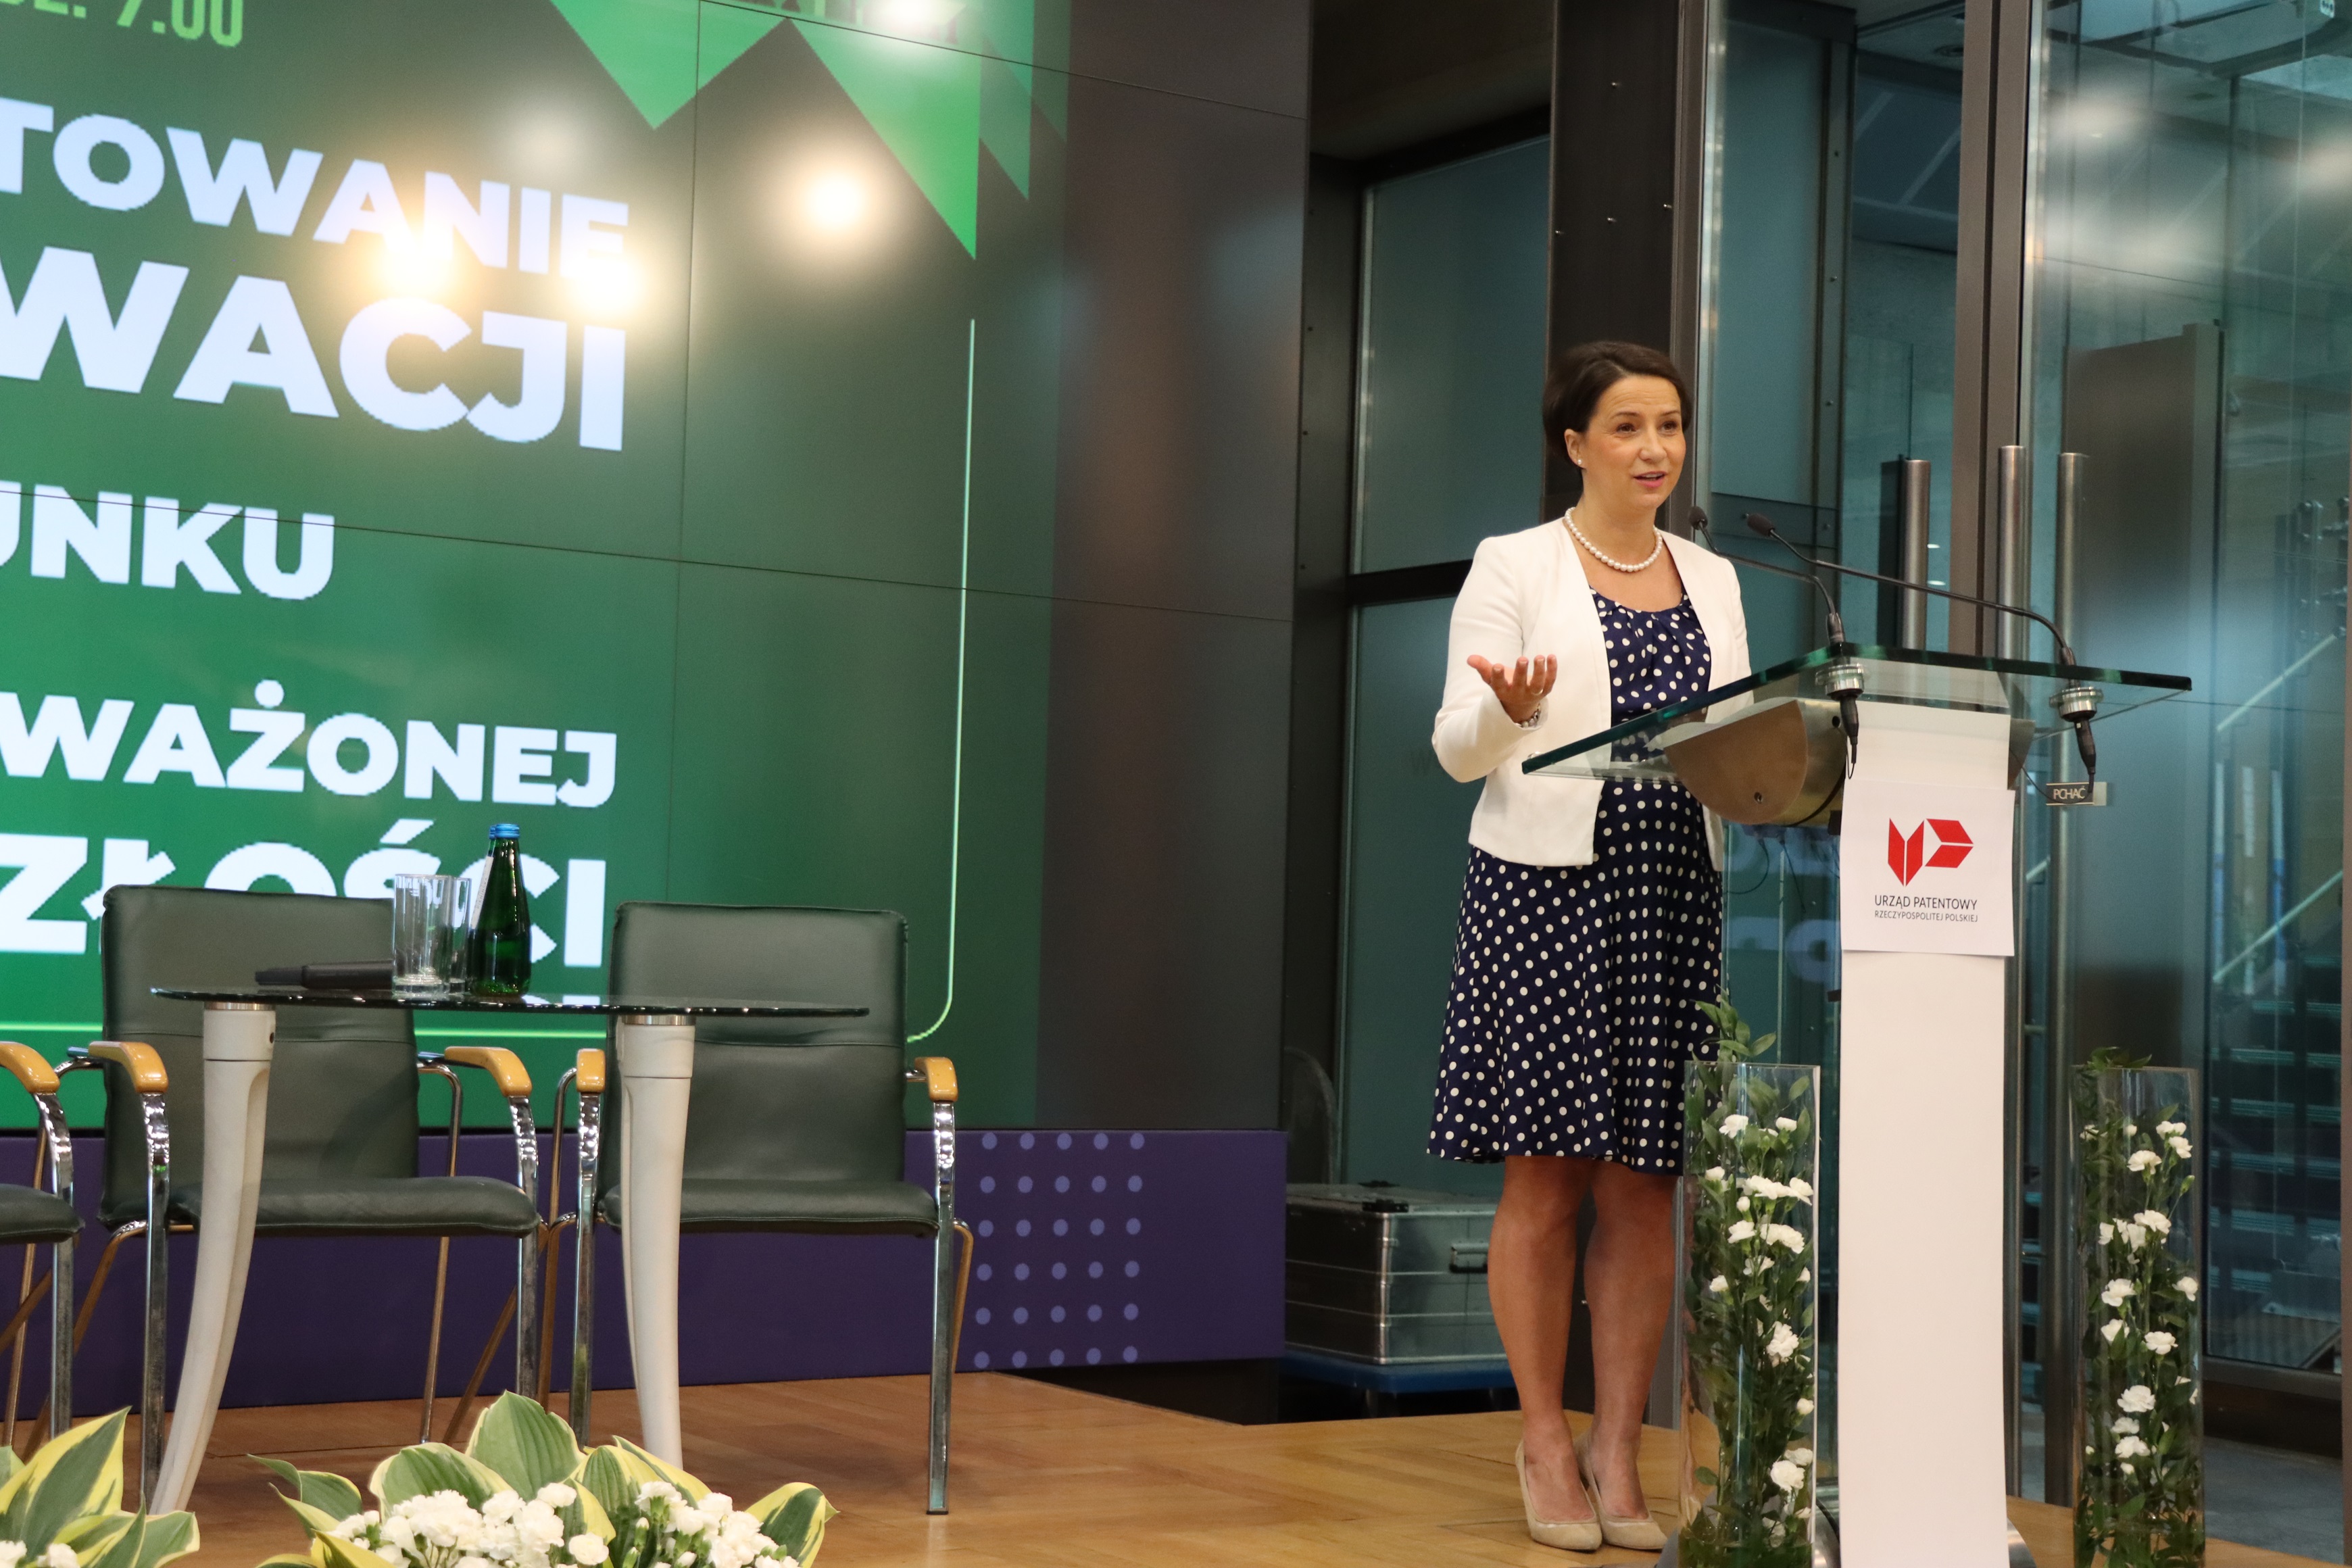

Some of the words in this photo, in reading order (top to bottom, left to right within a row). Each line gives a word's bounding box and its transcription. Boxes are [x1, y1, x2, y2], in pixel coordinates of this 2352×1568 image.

[0, 97, 630, 285] TOWANIE
[0, 246, 626, 451] WACJI
[0, 481, 335, 600] NKU
[0, 679, 617, 808] WAŻONEJ
[2053, 785, 2086, 800] PCHAĆ
[1874, 894, 1911, 909] URZĄD
[1913, 897, 1978, 910] PATENTOWY
[1874, 910, 1943, 921] RZECZYPOSPOLITEJ
[1945, 913, 1978, 923] POLSKIEJ
